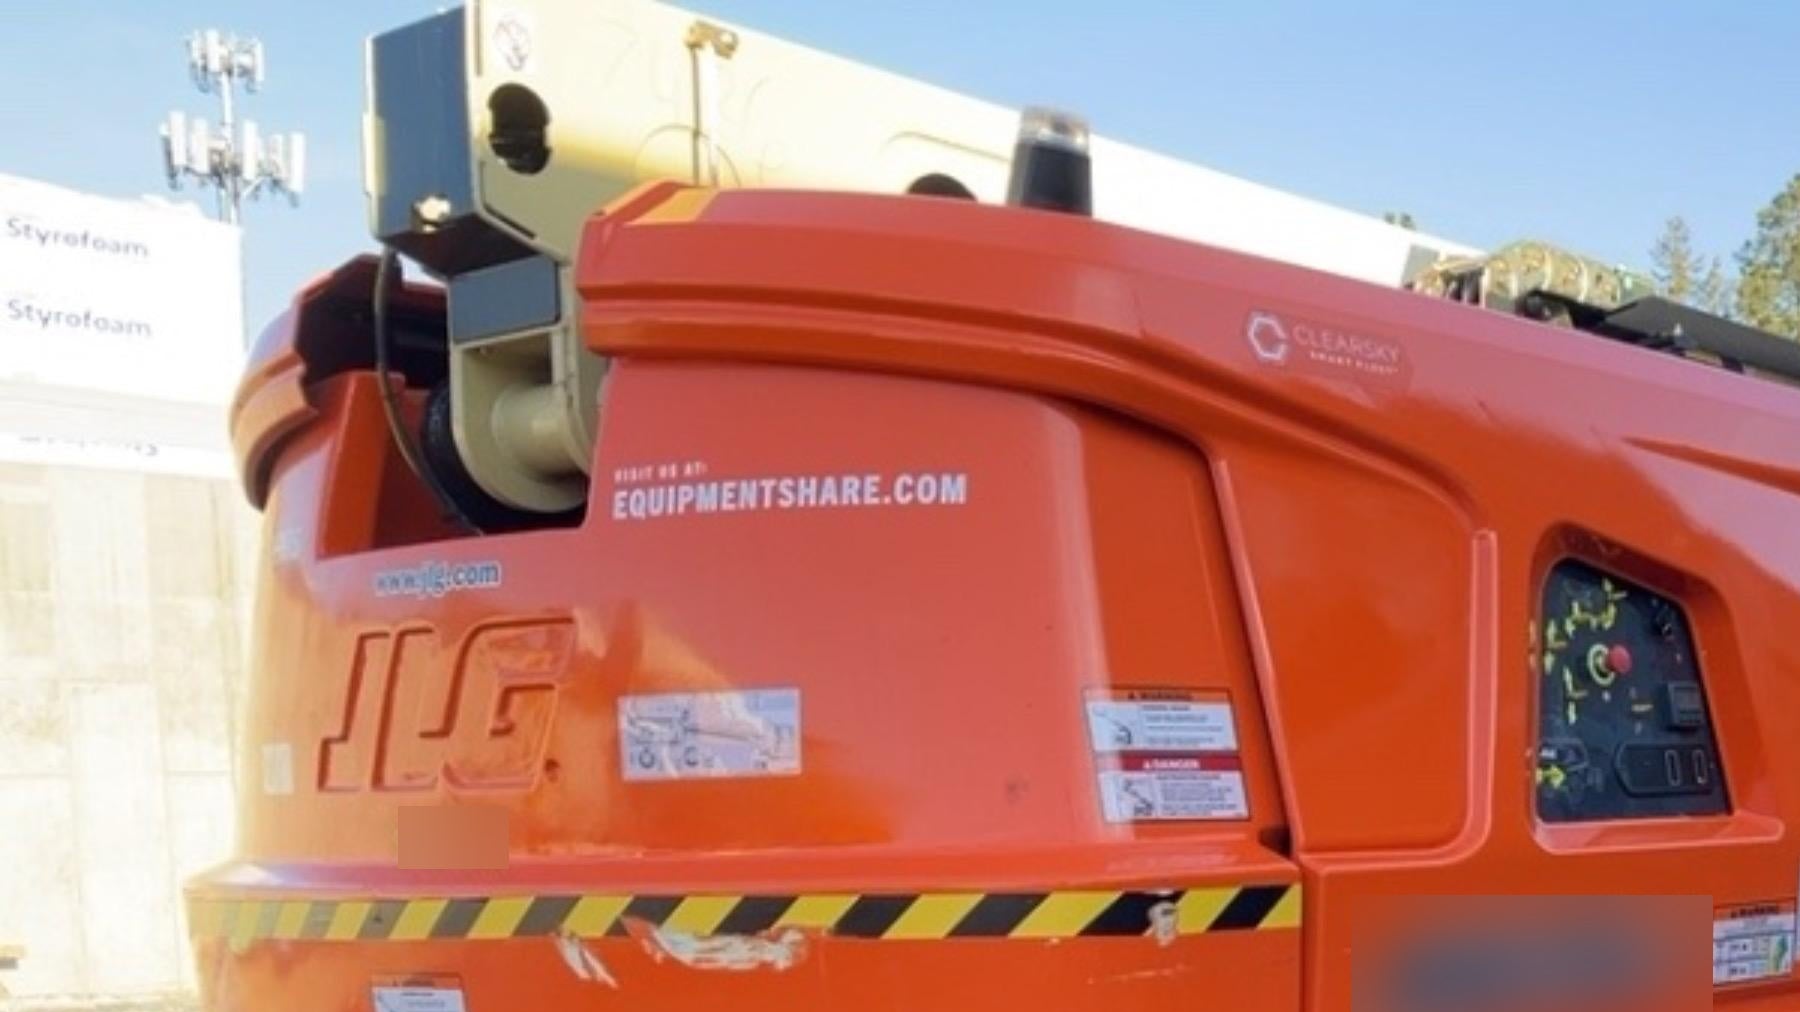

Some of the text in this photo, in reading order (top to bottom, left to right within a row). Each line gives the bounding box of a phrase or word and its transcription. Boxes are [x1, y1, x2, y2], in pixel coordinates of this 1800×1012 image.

[6, 216, 149, 258] Styrofoam
[8, 299, 153, 337] Styrofoam
[612, 471, 968, 521] EQUIPMENTSHARE.COM
[375, 563, 500, 598] www.jlg.com
[317, 615, 580, 796] JLG
